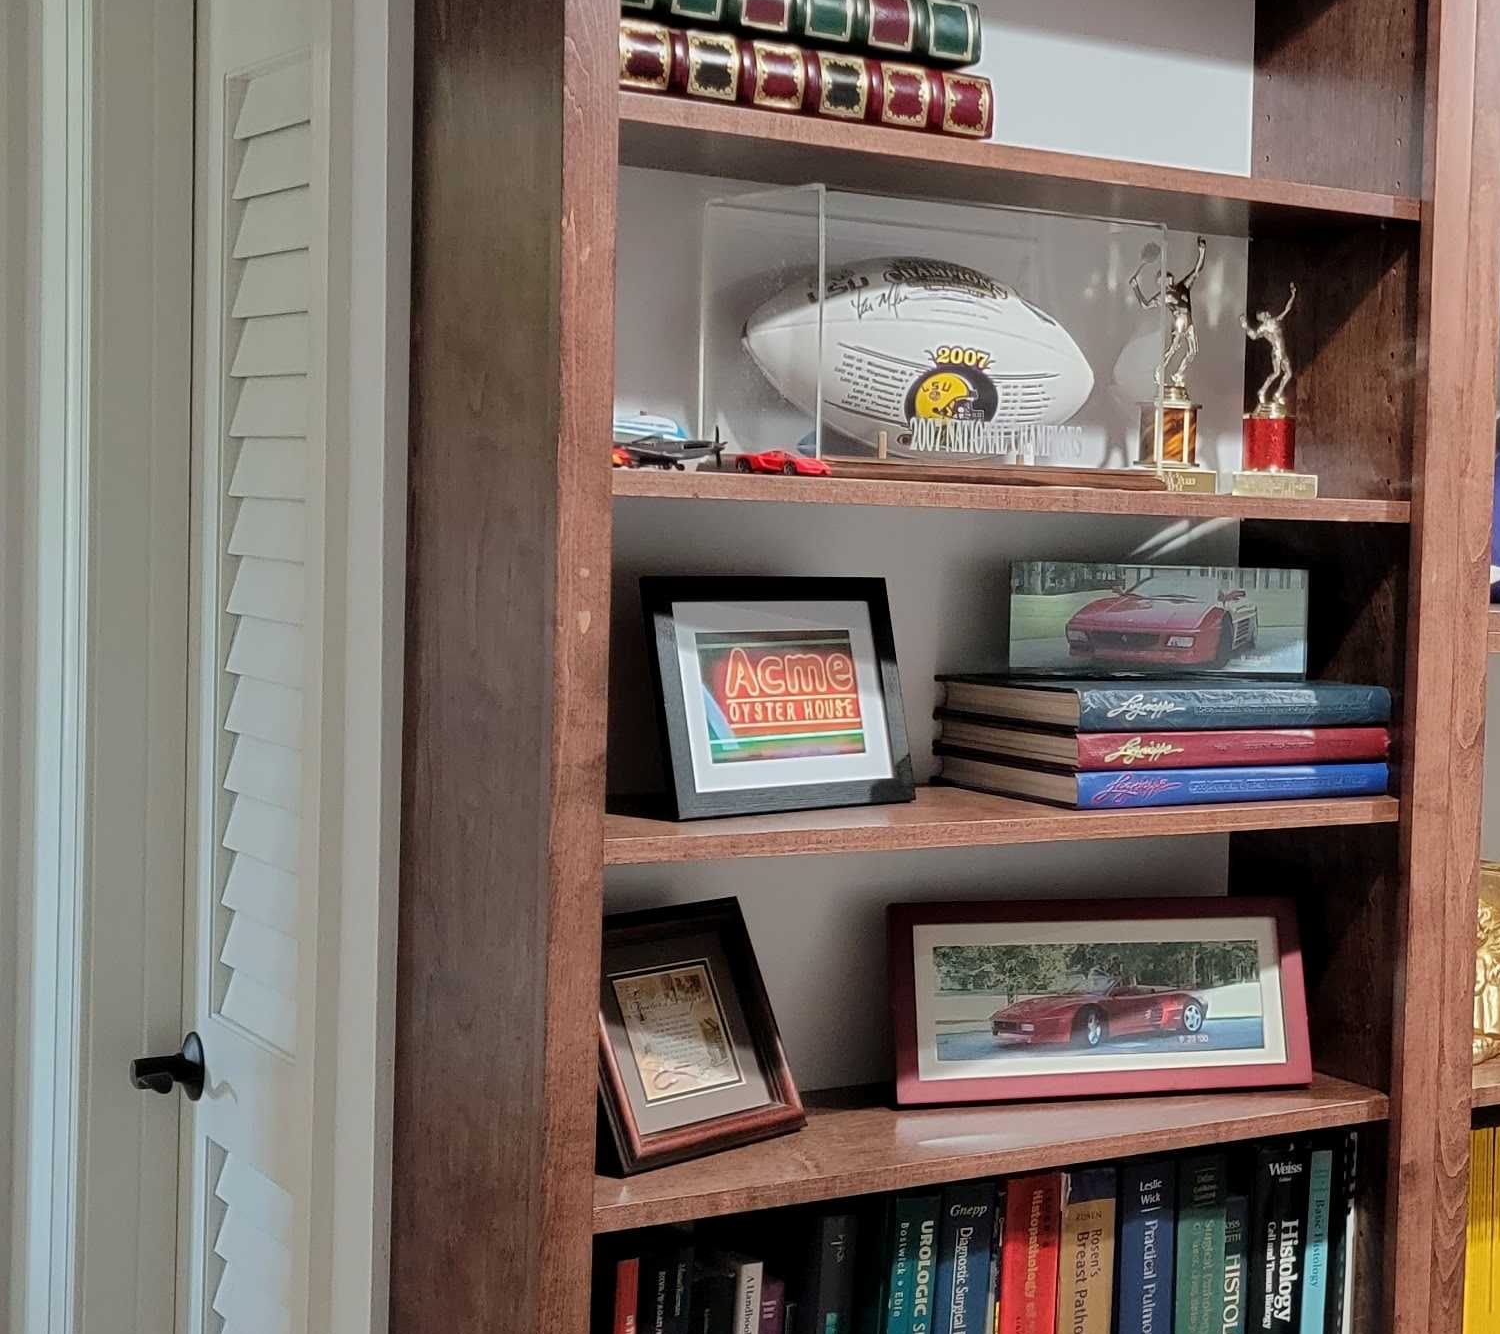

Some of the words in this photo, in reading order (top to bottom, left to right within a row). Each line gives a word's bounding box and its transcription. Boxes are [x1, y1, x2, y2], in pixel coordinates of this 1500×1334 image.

[936, 345, 991, 368] 2007
[922, 381, 952, 393] LSU
[909, 417, 941, 452] 2007
[945, 419, 1008, 455] NATIONAL
[1011, 424, 1083, 459] CHAMPIONS
[725, 647, 854, 698] Acme
[729, 701, 797, 723] OYSTER
[803, 698, 854, 721] HOUSE
[1139, 1179, 1163, 1191] Leslie
[1268, 1161, 1303, 1177] Weiss
[949, 1204, 988, 1217] Gnepp
[1140, 1192, 1161, 1205] Wick
[1314, 1199, 1326, 1229] Basic
[896, 1222, 910, 1275] Bostwick
[1025, 1189, 1044, 1299] Histopathology
[1142, 1219, 1159, 1280] Practical
[1265, 1243, 1276, 1261] and
[1267, 1221, 1278, 1242] Cell
[914, 1220, 935, 1318] UROLOGIC
[956, 1227, 974, 1285] Diagnostic
[1074, 1231, 1090, 1283] Breast
[1090, 1228, 1103, 1278] Rosen's
[1273, 1219, 1299, 1323] Histology
[1309, 1231, 1324, 1289] Histology
[952, 1286, 969, 1330] Surgical
[1262, 1294, 1273, 1330] Biology
